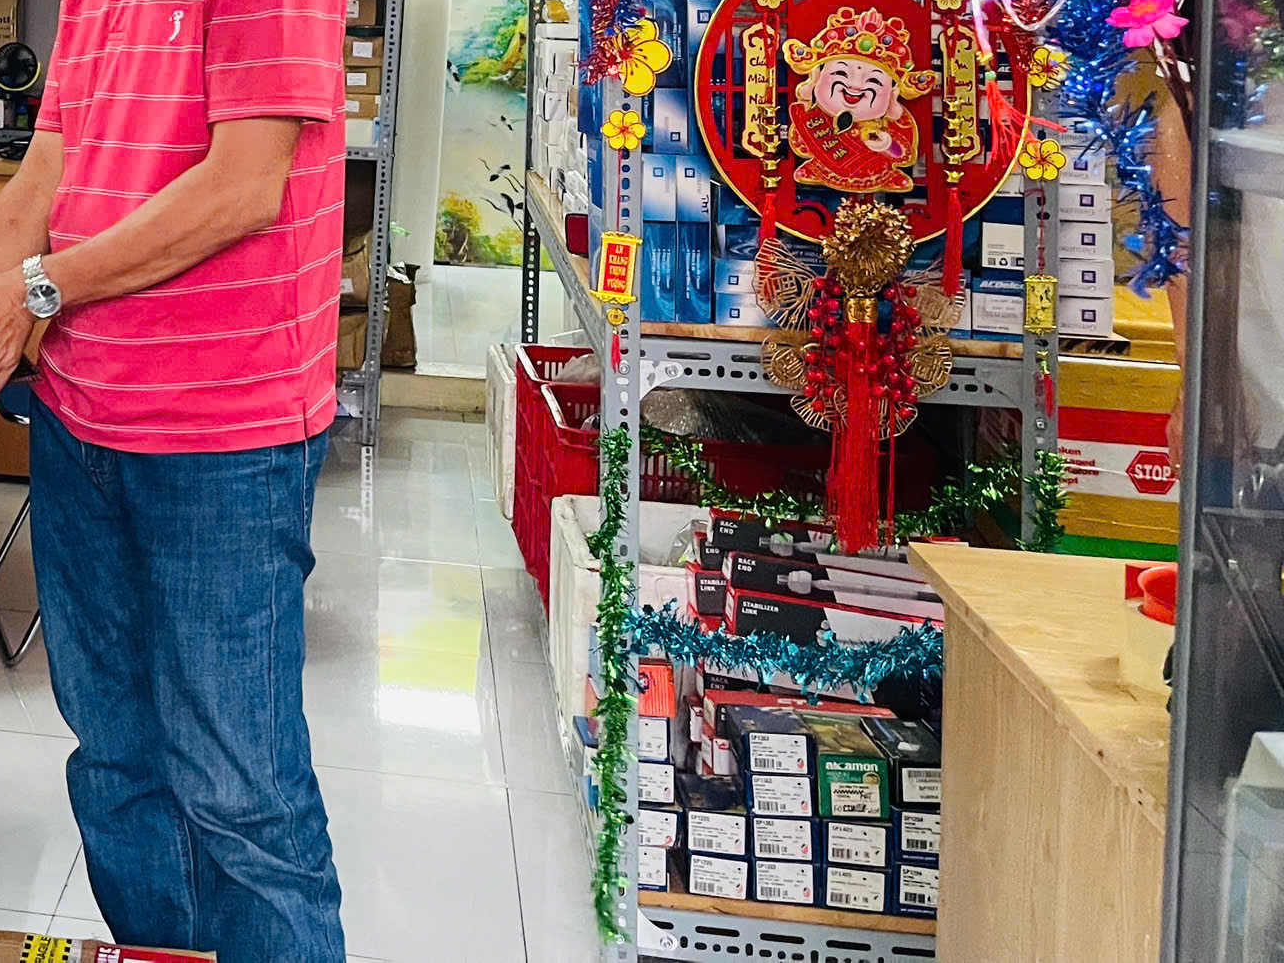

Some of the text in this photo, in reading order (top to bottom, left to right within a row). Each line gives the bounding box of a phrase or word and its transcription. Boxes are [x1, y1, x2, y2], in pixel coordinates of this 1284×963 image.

[1135, 464, 1172, 481] STOP
[719, 527, 734, 535] END
[738, 557, 756, 566] RACK
[742, 601, 779, 613] STABILIZER
[742, 607, 758, 615] LINK
